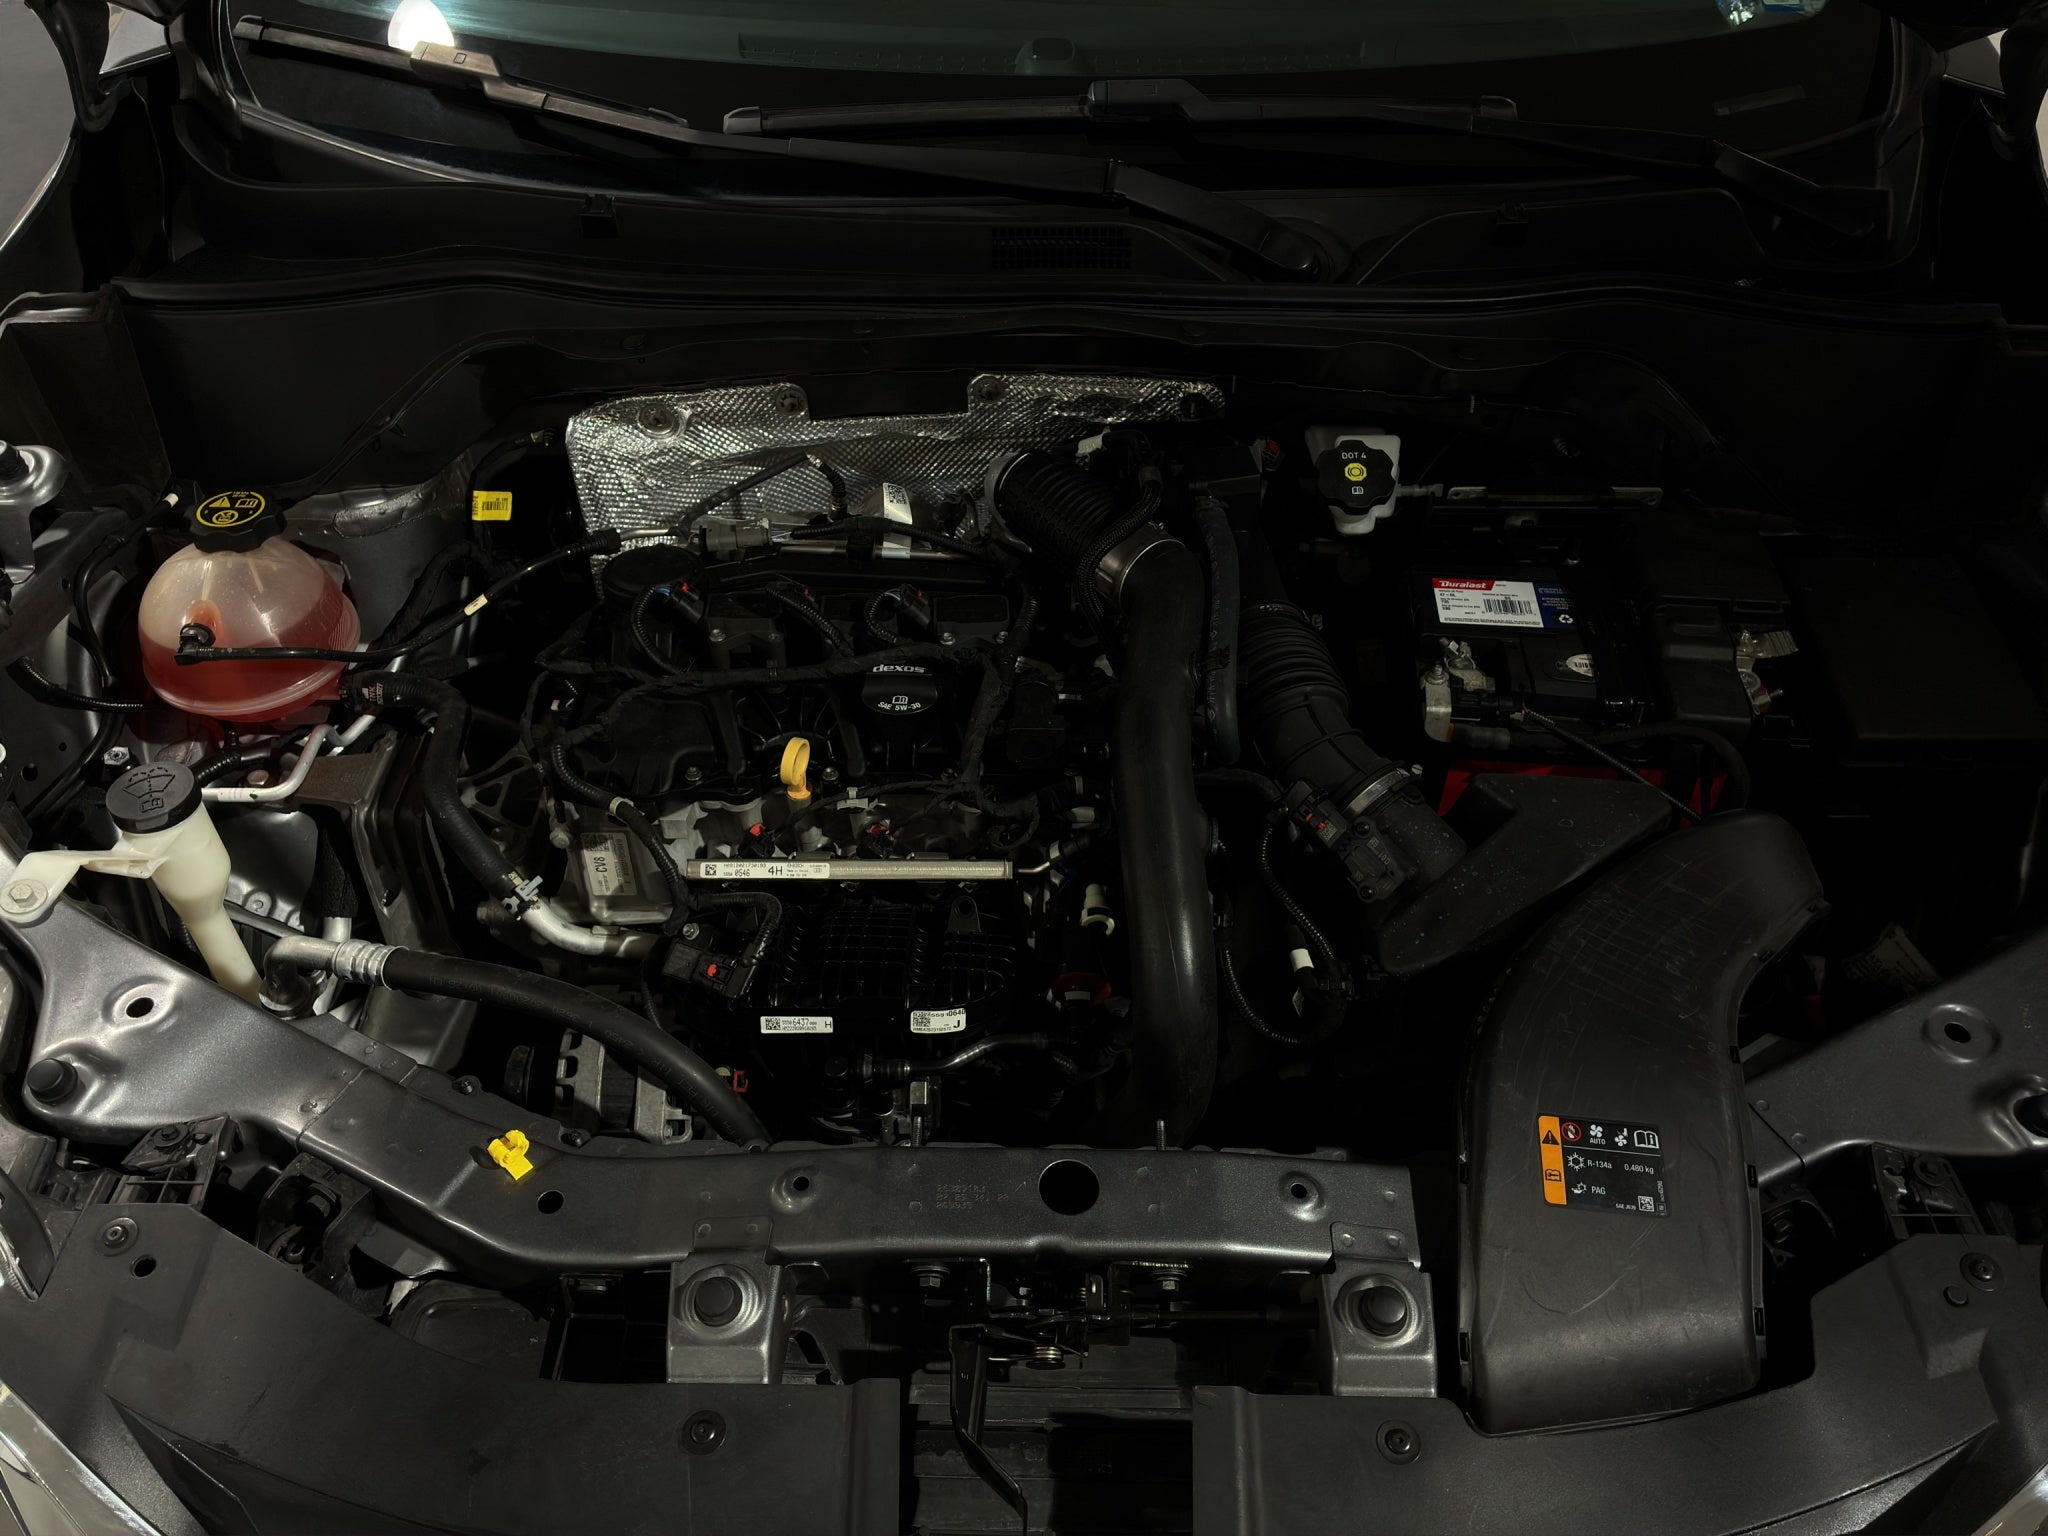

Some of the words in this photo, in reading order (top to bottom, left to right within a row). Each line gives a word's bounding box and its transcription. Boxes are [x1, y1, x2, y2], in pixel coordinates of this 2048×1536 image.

[1361, 451, 1367, 459] 4
[1439, 580, 1487, 589] Duralast
[872, 664, 925, 673] dexos
[878, 701, 893, 710] SAE
[894, 702, 922, 711] 5W-30
[594, 856, 608, 873] CV8
[768, 865, 783, 876] 4H
[824, 1020, 832, 1028] H
[953, 1019, 961, 1028] J
[1590, 1137, 1606, 1145] AUTO
[1587, 1160, 1612, 1169] R-134a
[1624, 1163, 1644, 1173] 0.480
[1645, 1167, 1654, 1175] kg
[1591, 1186, 1606, 1195] PAG
